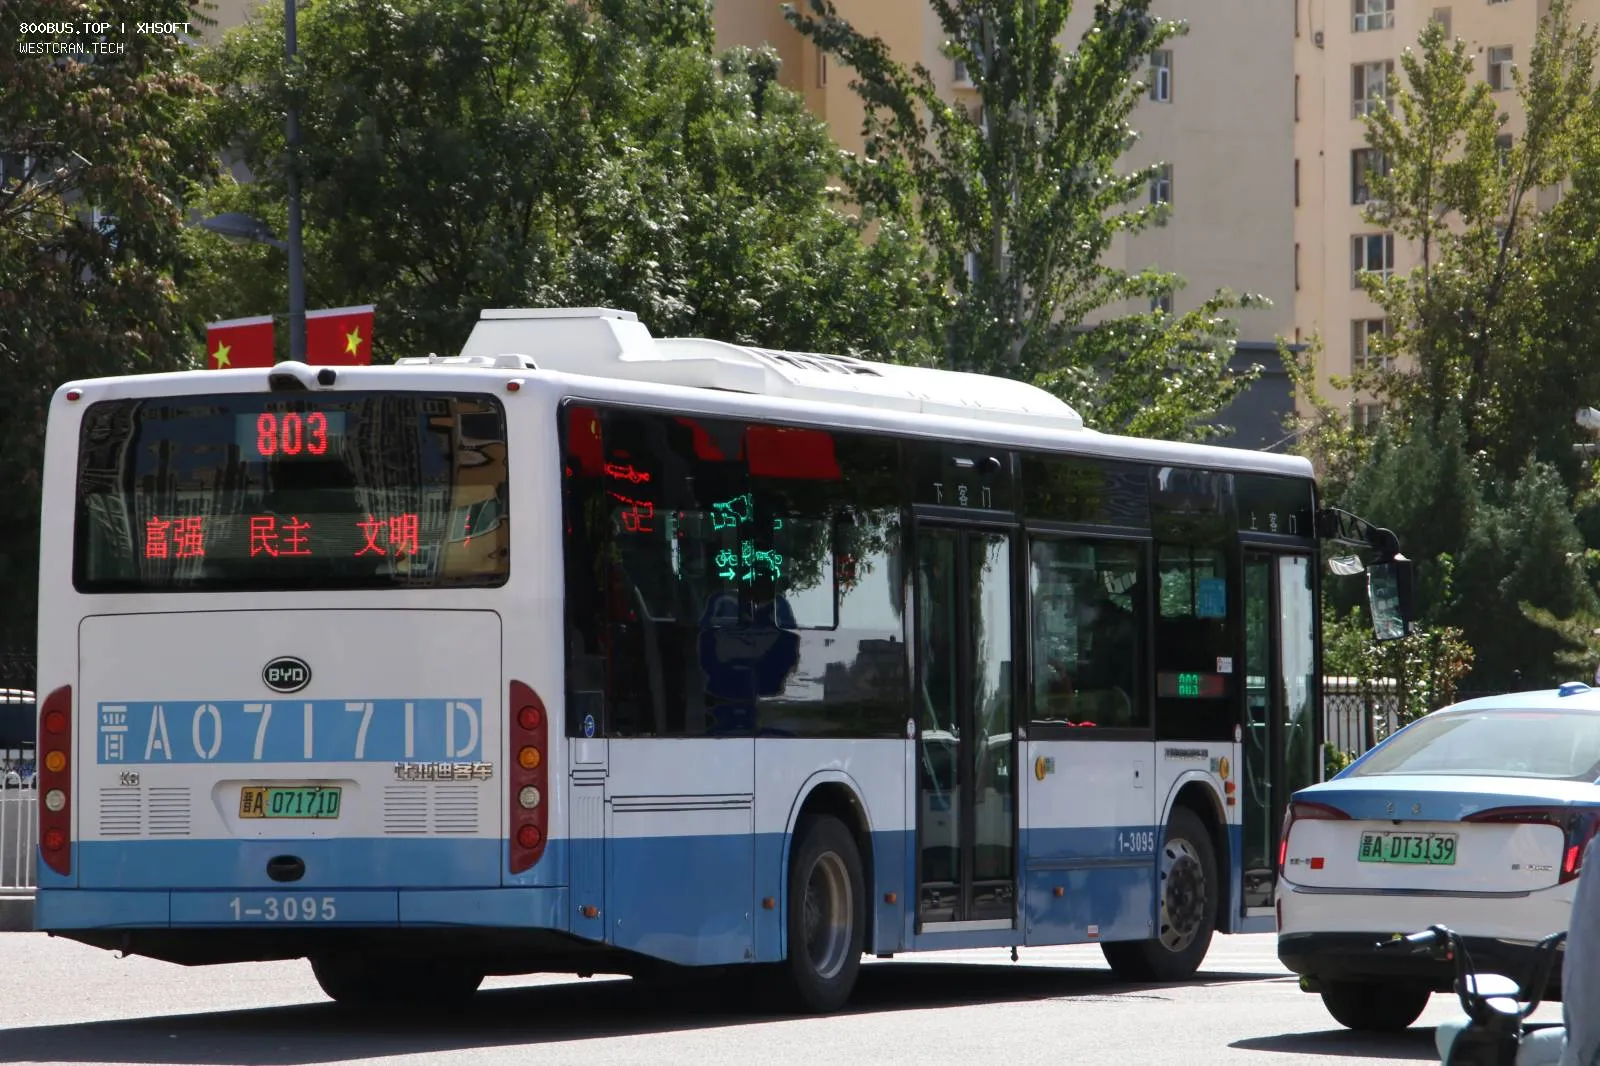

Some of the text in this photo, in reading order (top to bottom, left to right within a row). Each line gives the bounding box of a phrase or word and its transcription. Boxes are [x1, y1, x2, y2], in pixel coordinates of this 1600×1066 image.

[256, 411, 328, 456] 803
[933, 482, 992, 508] 下客门
[145, 516, 205, 560] 富强
[250, 515, 312, 557] 民主
[354, 513, 418, 557] 文明
[268, 668, 303, 682] BYD
[1118, 831, 1154, 853] 1-3095
[229, 896, 336, 921] 1-3095
